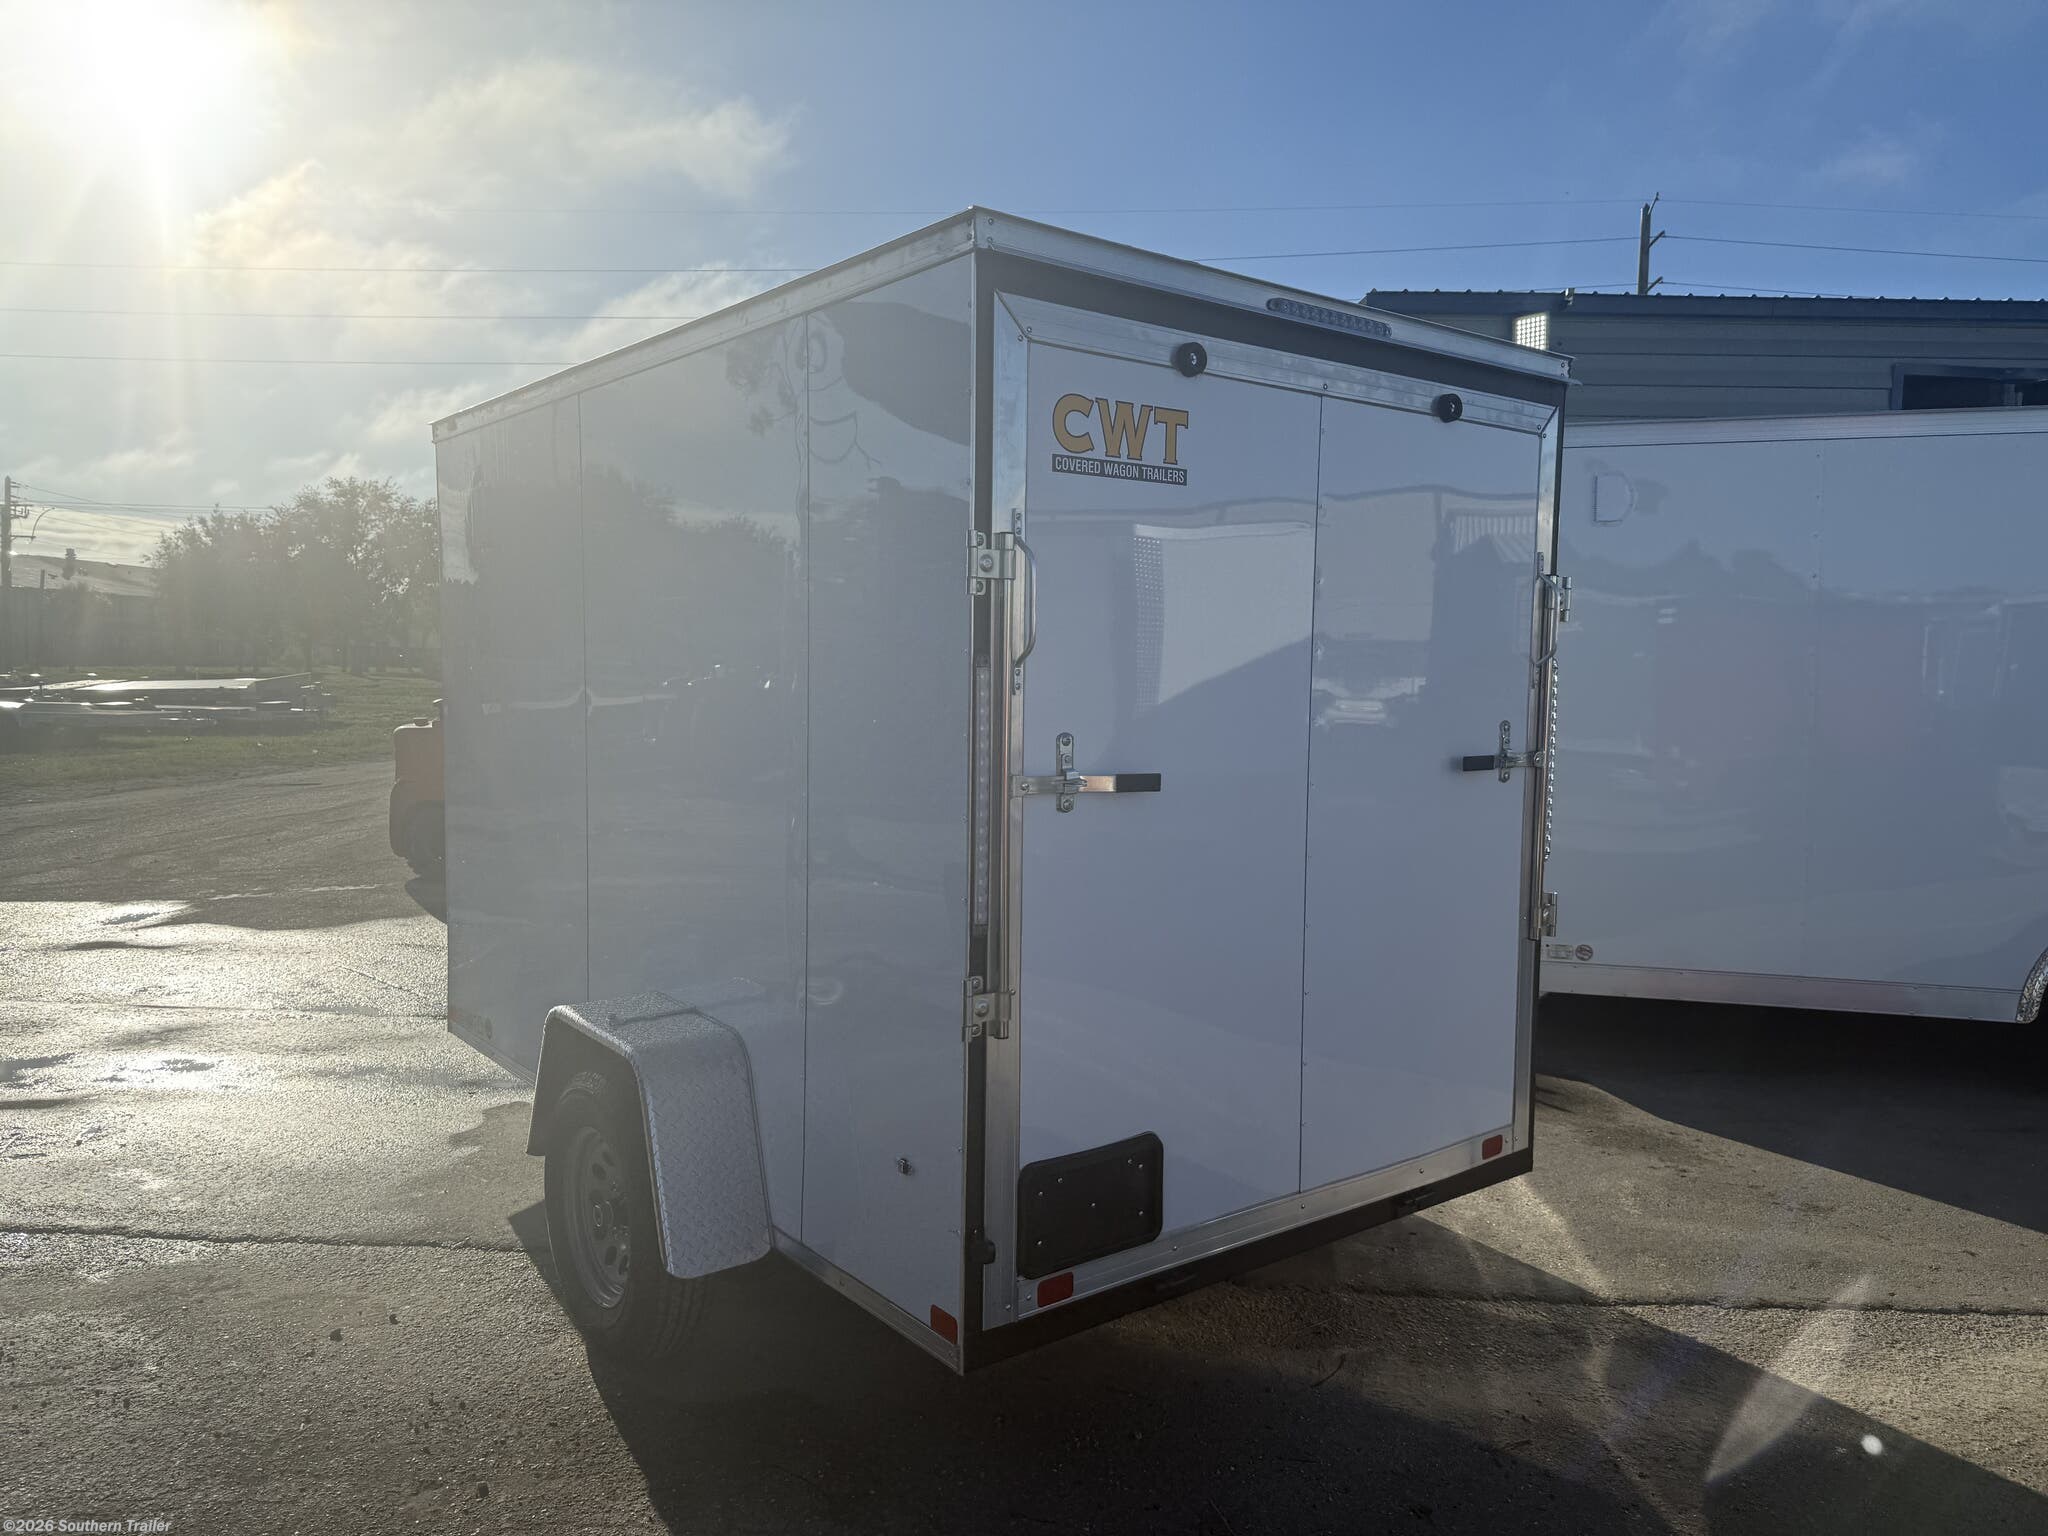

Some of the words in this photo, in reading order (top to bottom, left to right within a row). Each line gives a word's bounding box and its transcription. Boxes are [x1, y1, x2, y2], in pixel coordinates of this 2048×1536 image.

[1053, 393, 1189, 465] CWT
[1055, 456, 1101, 474] COVERED
[1104, 462, 1139, 479] WAGON
[1142, 466, 1185, 483] TRAILERS
